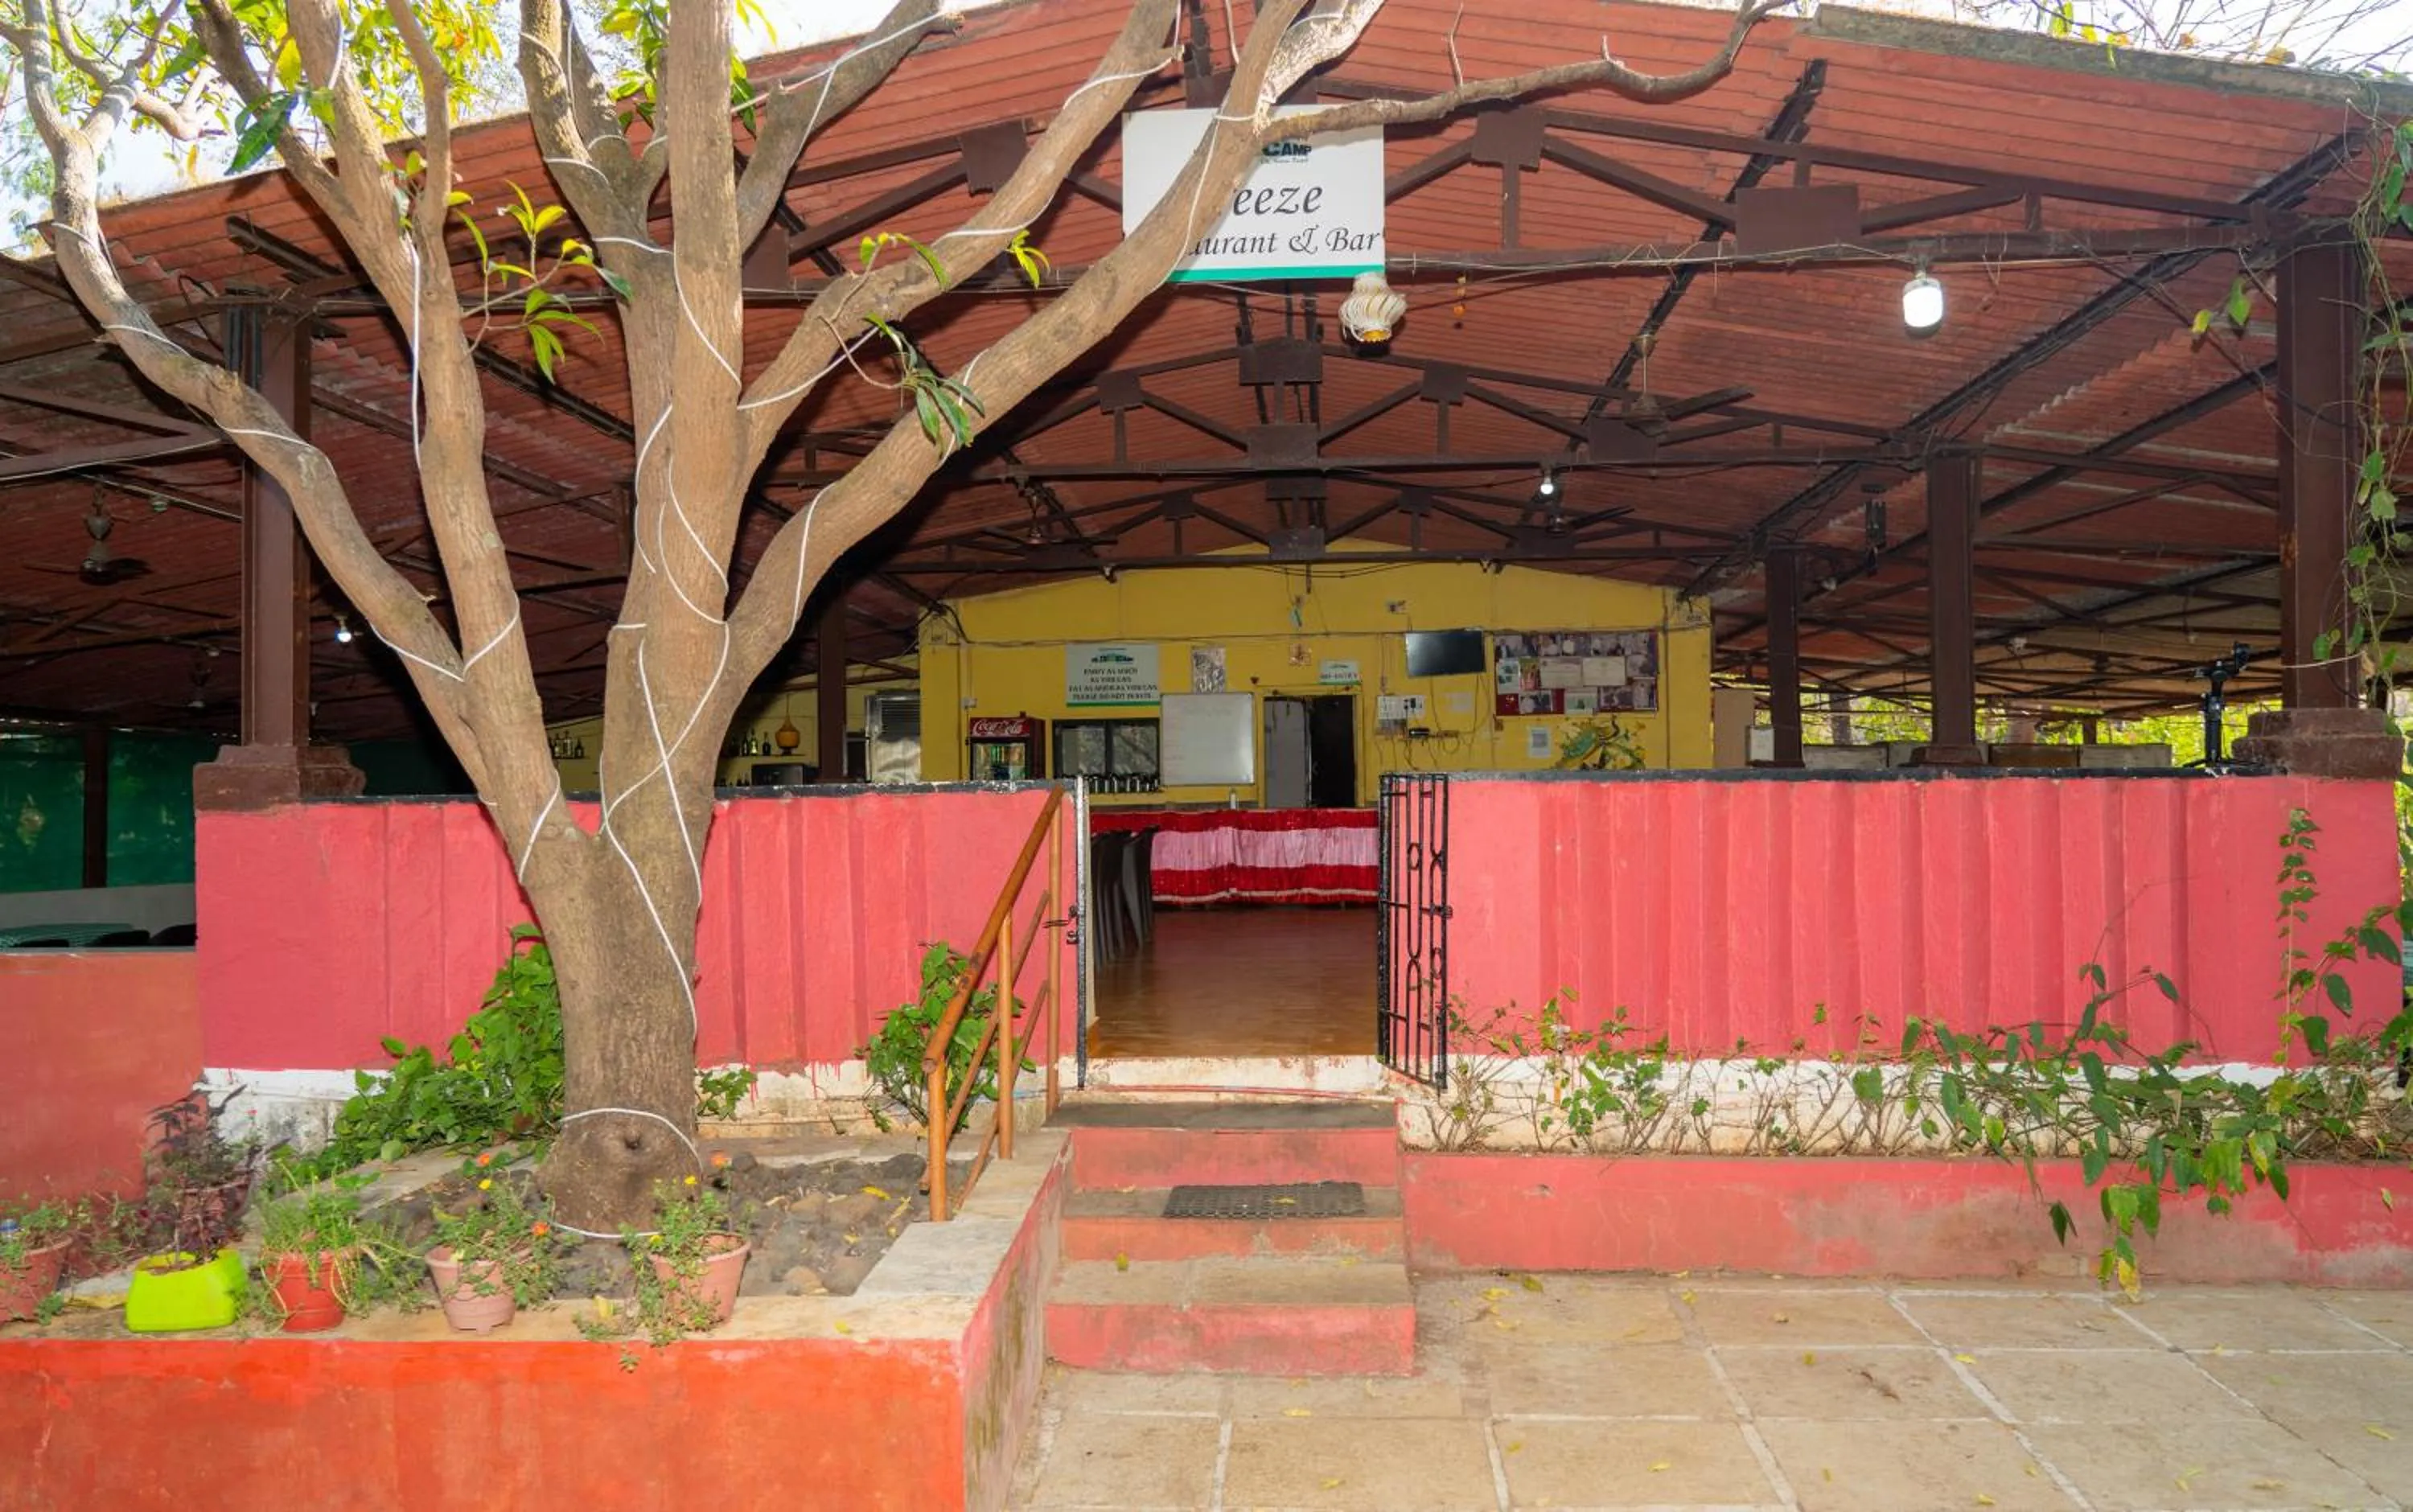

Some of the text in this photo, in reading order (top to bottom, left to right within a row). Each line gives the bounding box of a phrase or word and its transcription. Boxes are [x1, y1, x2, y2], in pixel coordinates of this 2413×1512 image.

[1233, 186, 1322, 216] eeze
[1289, 224, 1318, 255] &
[1326, 227, 1380, 252] Bar
